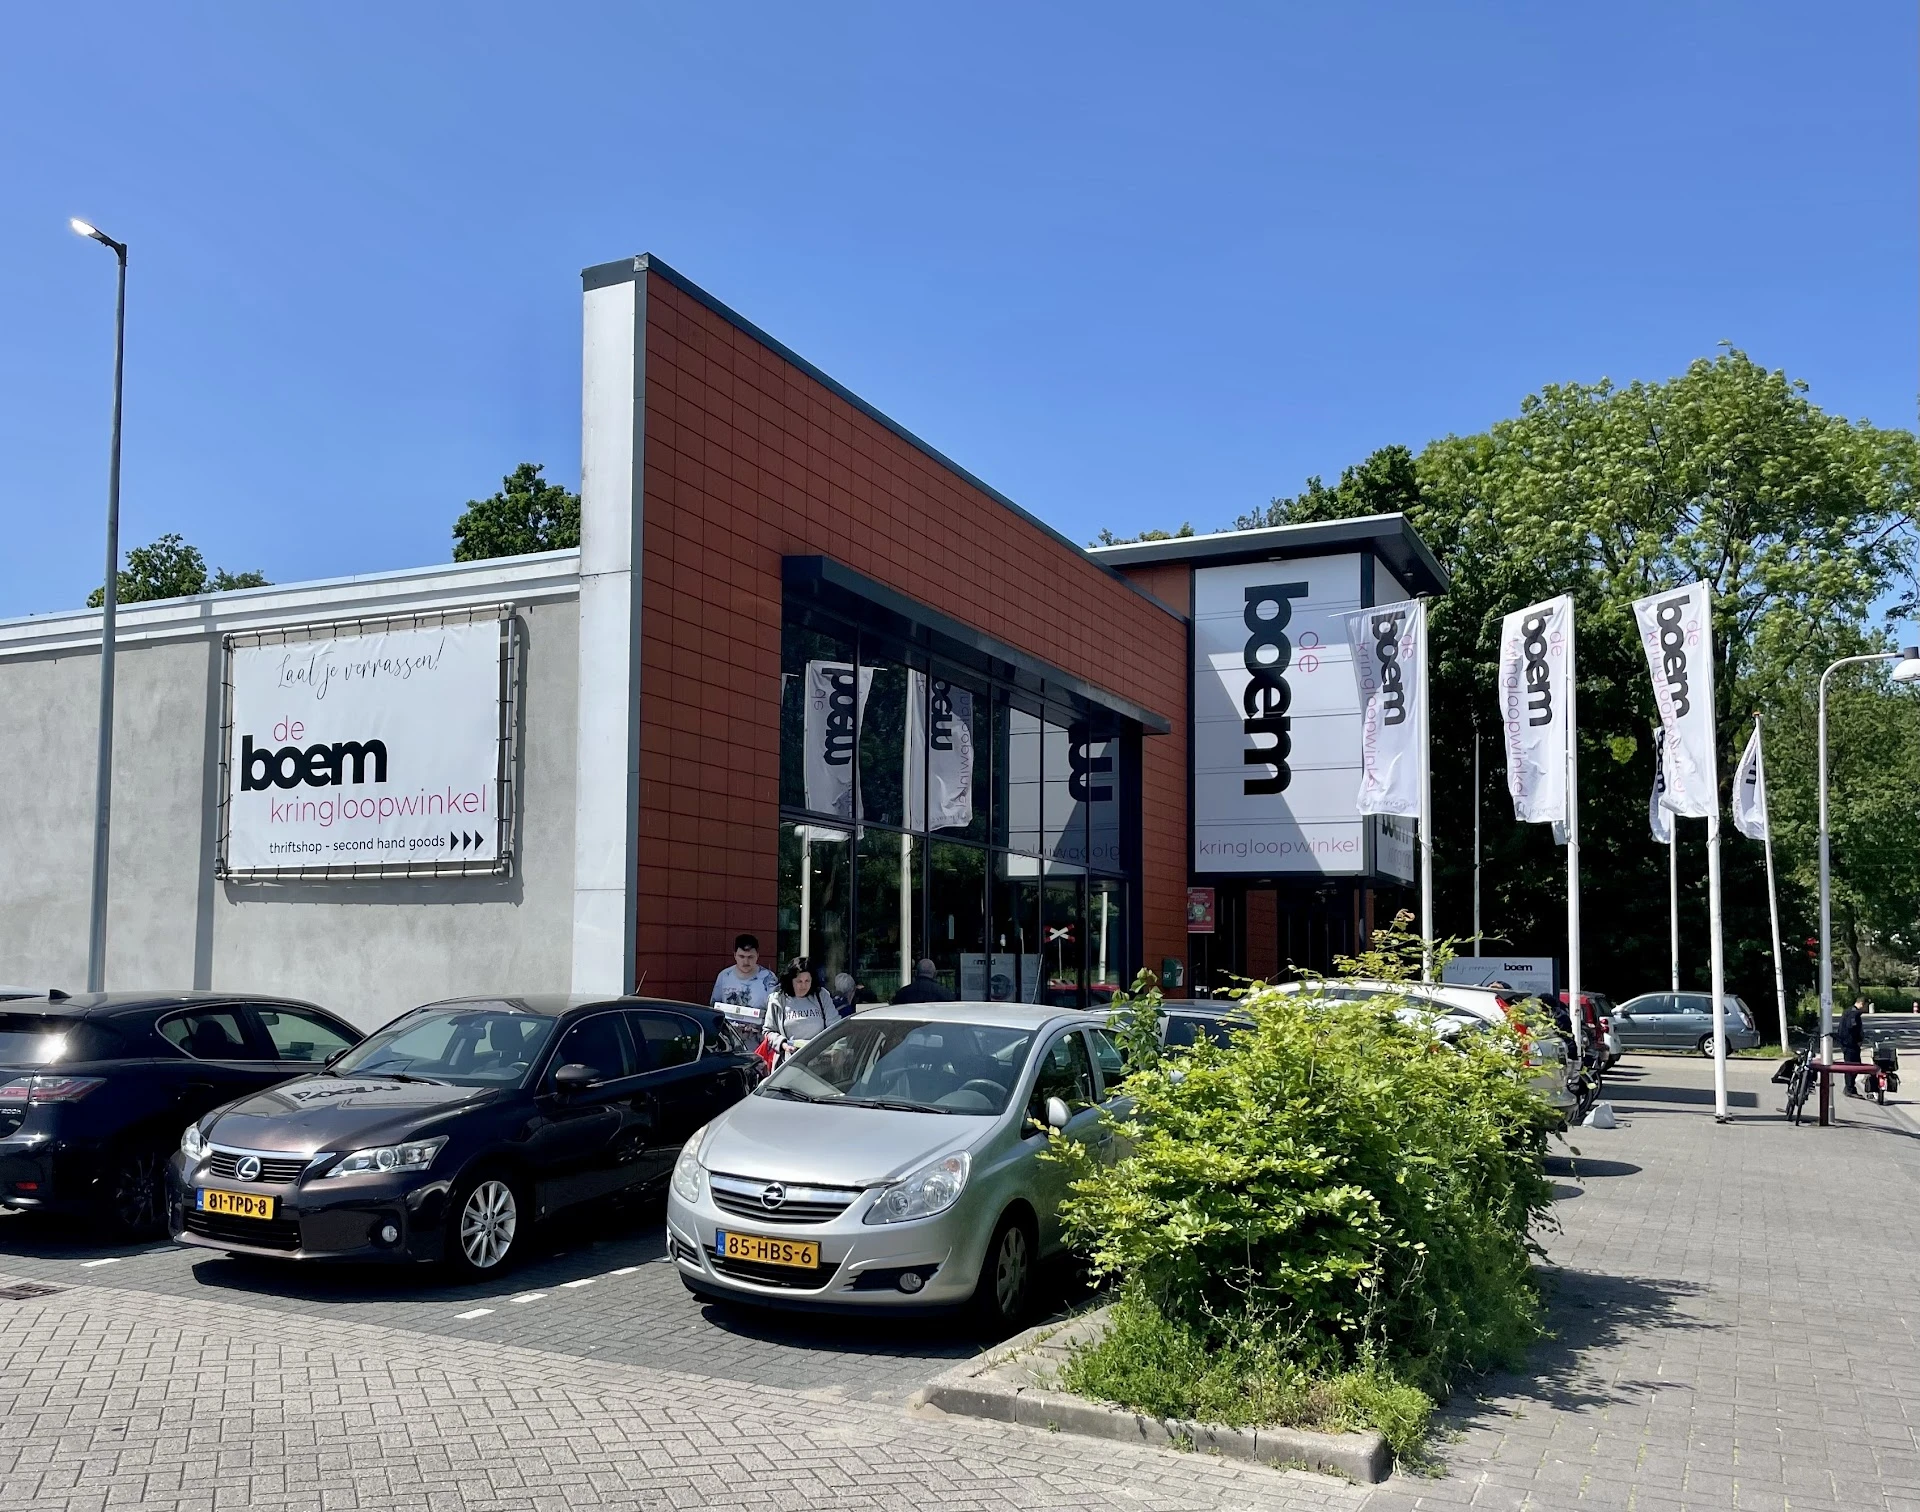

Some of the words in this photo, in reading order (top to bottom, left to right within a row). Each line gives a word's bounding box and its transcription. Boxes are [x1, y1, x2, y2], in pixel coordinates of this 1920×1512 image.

[1401, 634, 1417, 660] de
[1550, 631, 1566, 657] de
[1687, 619, 1701, 647] de
[1299, 631, 1326, 672] de
[1657, 594, 1690, 718] boem
[276, 653, 334, 688] Laat
[316, 663, 338, 700] je
[345, 636, 446, 680] verrassen!
[1371, 611, 1406, 726] boem
[1521, 607, 1553, 727] boem
[1244, 582, 1308, 795] boem
[273, 715, 305, 742] de
[1503, 637, 1528, 798] kringloopwinkel
[240, 734, 388, 791] boem
[270, 784, 486, 828] kringloopwinkel
[269, 841, 323, 854] thriftshop
[333, 838, 374, 851] second
[377, 836, 406, 849] hand
[409, 835, 446, 851] goods
[1198, 836, 1360, 858] kringloopwinkel
[1503, 962, 1533, 972] boem
[785, 1008, 823, 1020] HARVAR
[209, 1193, 267, 1216] 81-TPD-8
[729, 1237, 812, 1264] 85-HBS-6
